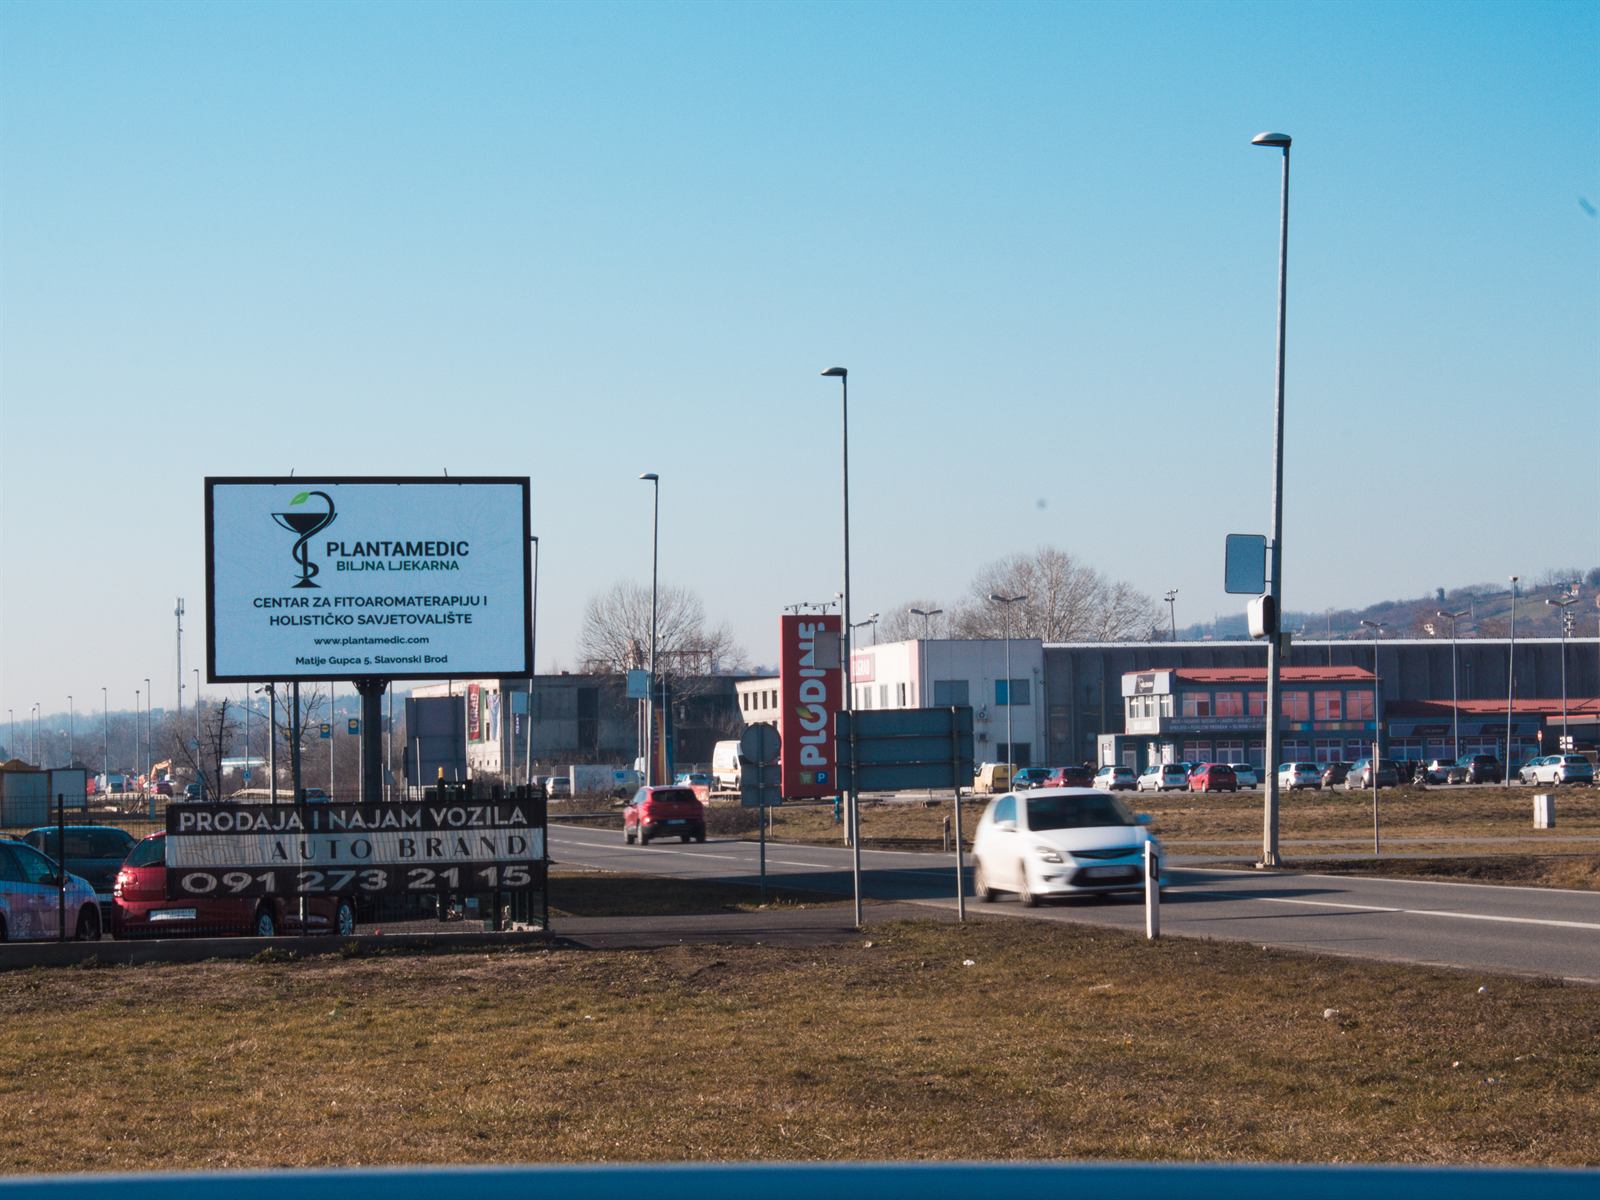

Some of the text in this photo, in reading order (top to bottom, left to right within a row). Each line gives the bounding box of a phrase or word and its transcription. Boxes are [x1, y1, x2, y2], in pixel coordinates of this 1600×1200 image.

[326, 541, 470, 557] PLANTAMEDIC
[336, 560, 459, 571] BILJNA LJEKARNA
[253, 597, 310, 608] CENTAR
[313, 597, 331, 607] ZA
[334, 596, 480, 607] FITOAROMATERAPIJU
[269, 611, 472, 626] HOLISTIČKO SAVJETOVALIŠTE
[314, 635, 430, 646] www.plantamedic.com
[295, 656, 327, 666] Matije
[329, 656, 361, 667] Gupca
[374, 655, 422, 664] Slavonski
[424, 655, 448, 664] Brod
[179, 805, 528, 832] PRODAJA I NAJAM VOZILA
[271, 834, 527, 861] AUTO BRAND
[181, 865, 531, 893] 091 273 21 15
